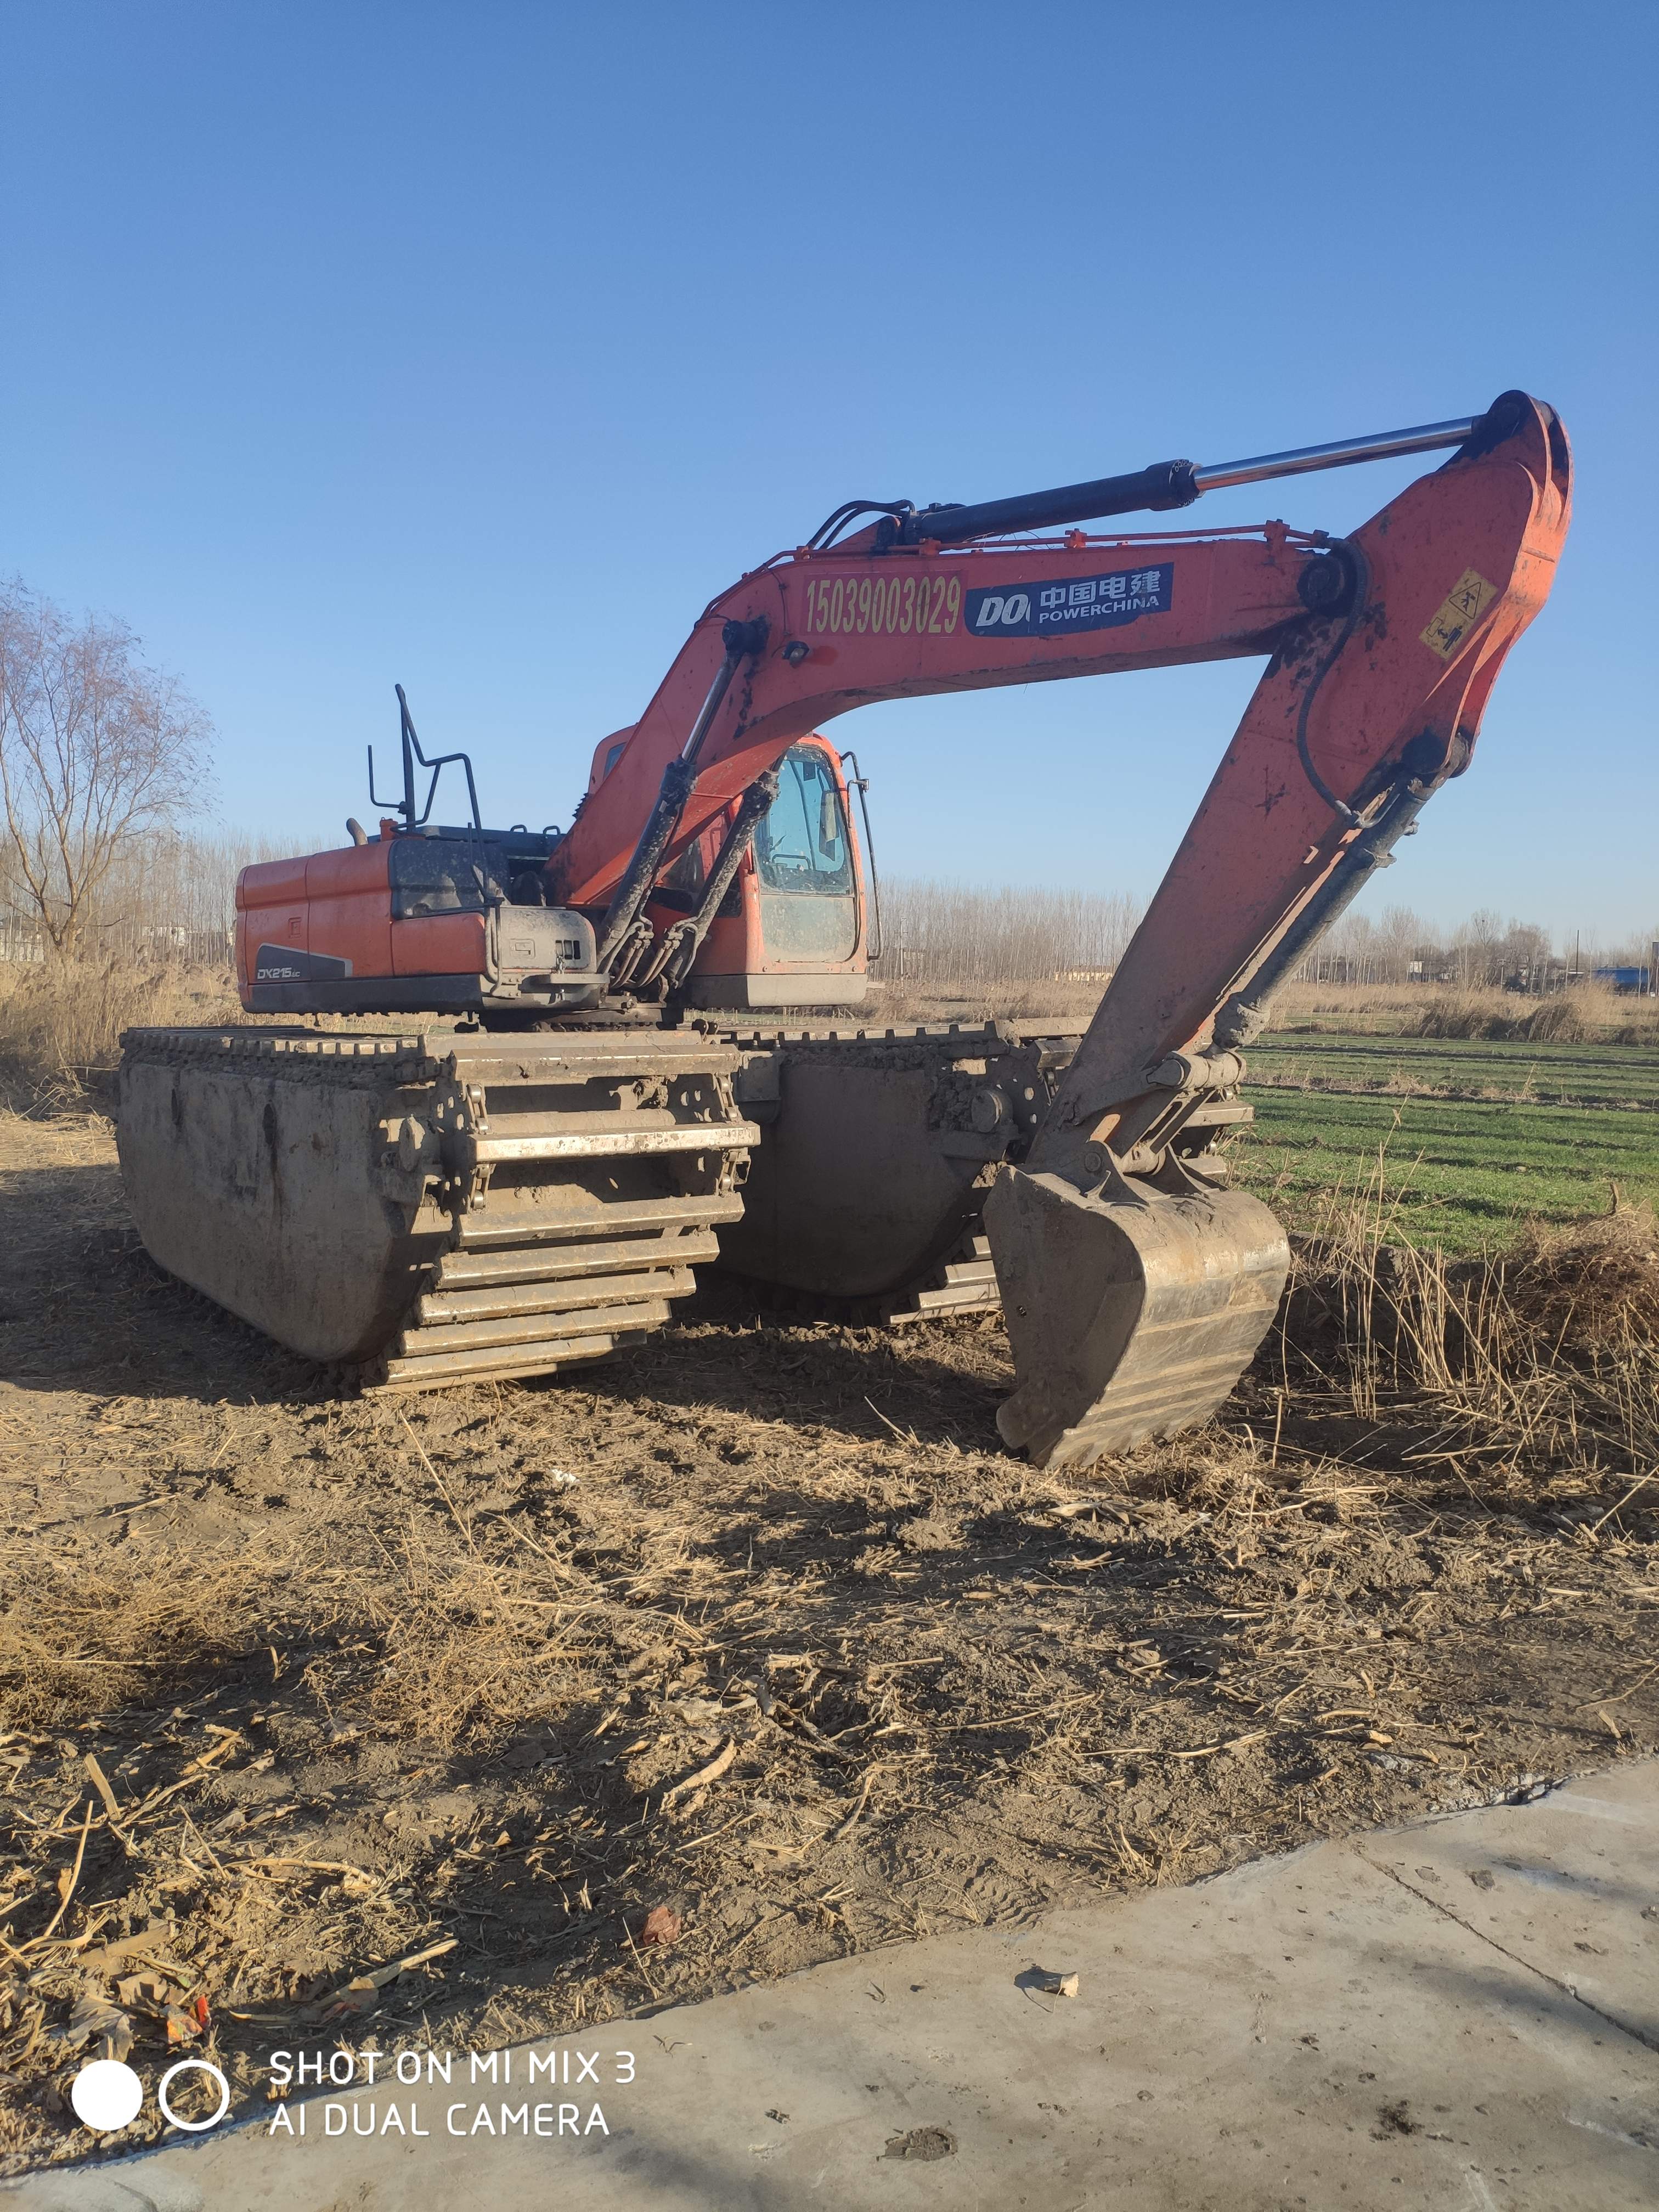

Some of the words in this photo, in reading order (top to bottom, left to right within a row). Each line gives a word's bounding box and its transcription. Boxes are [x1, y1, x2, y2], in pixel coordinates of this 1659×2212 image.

[807, 575, 960, 634] 15039003029
[1040, 571, 1161, 609] 中国电建
[975, 594, 1031, 628] DO
[1039, 595, 1160, 624] POWERCHINA
